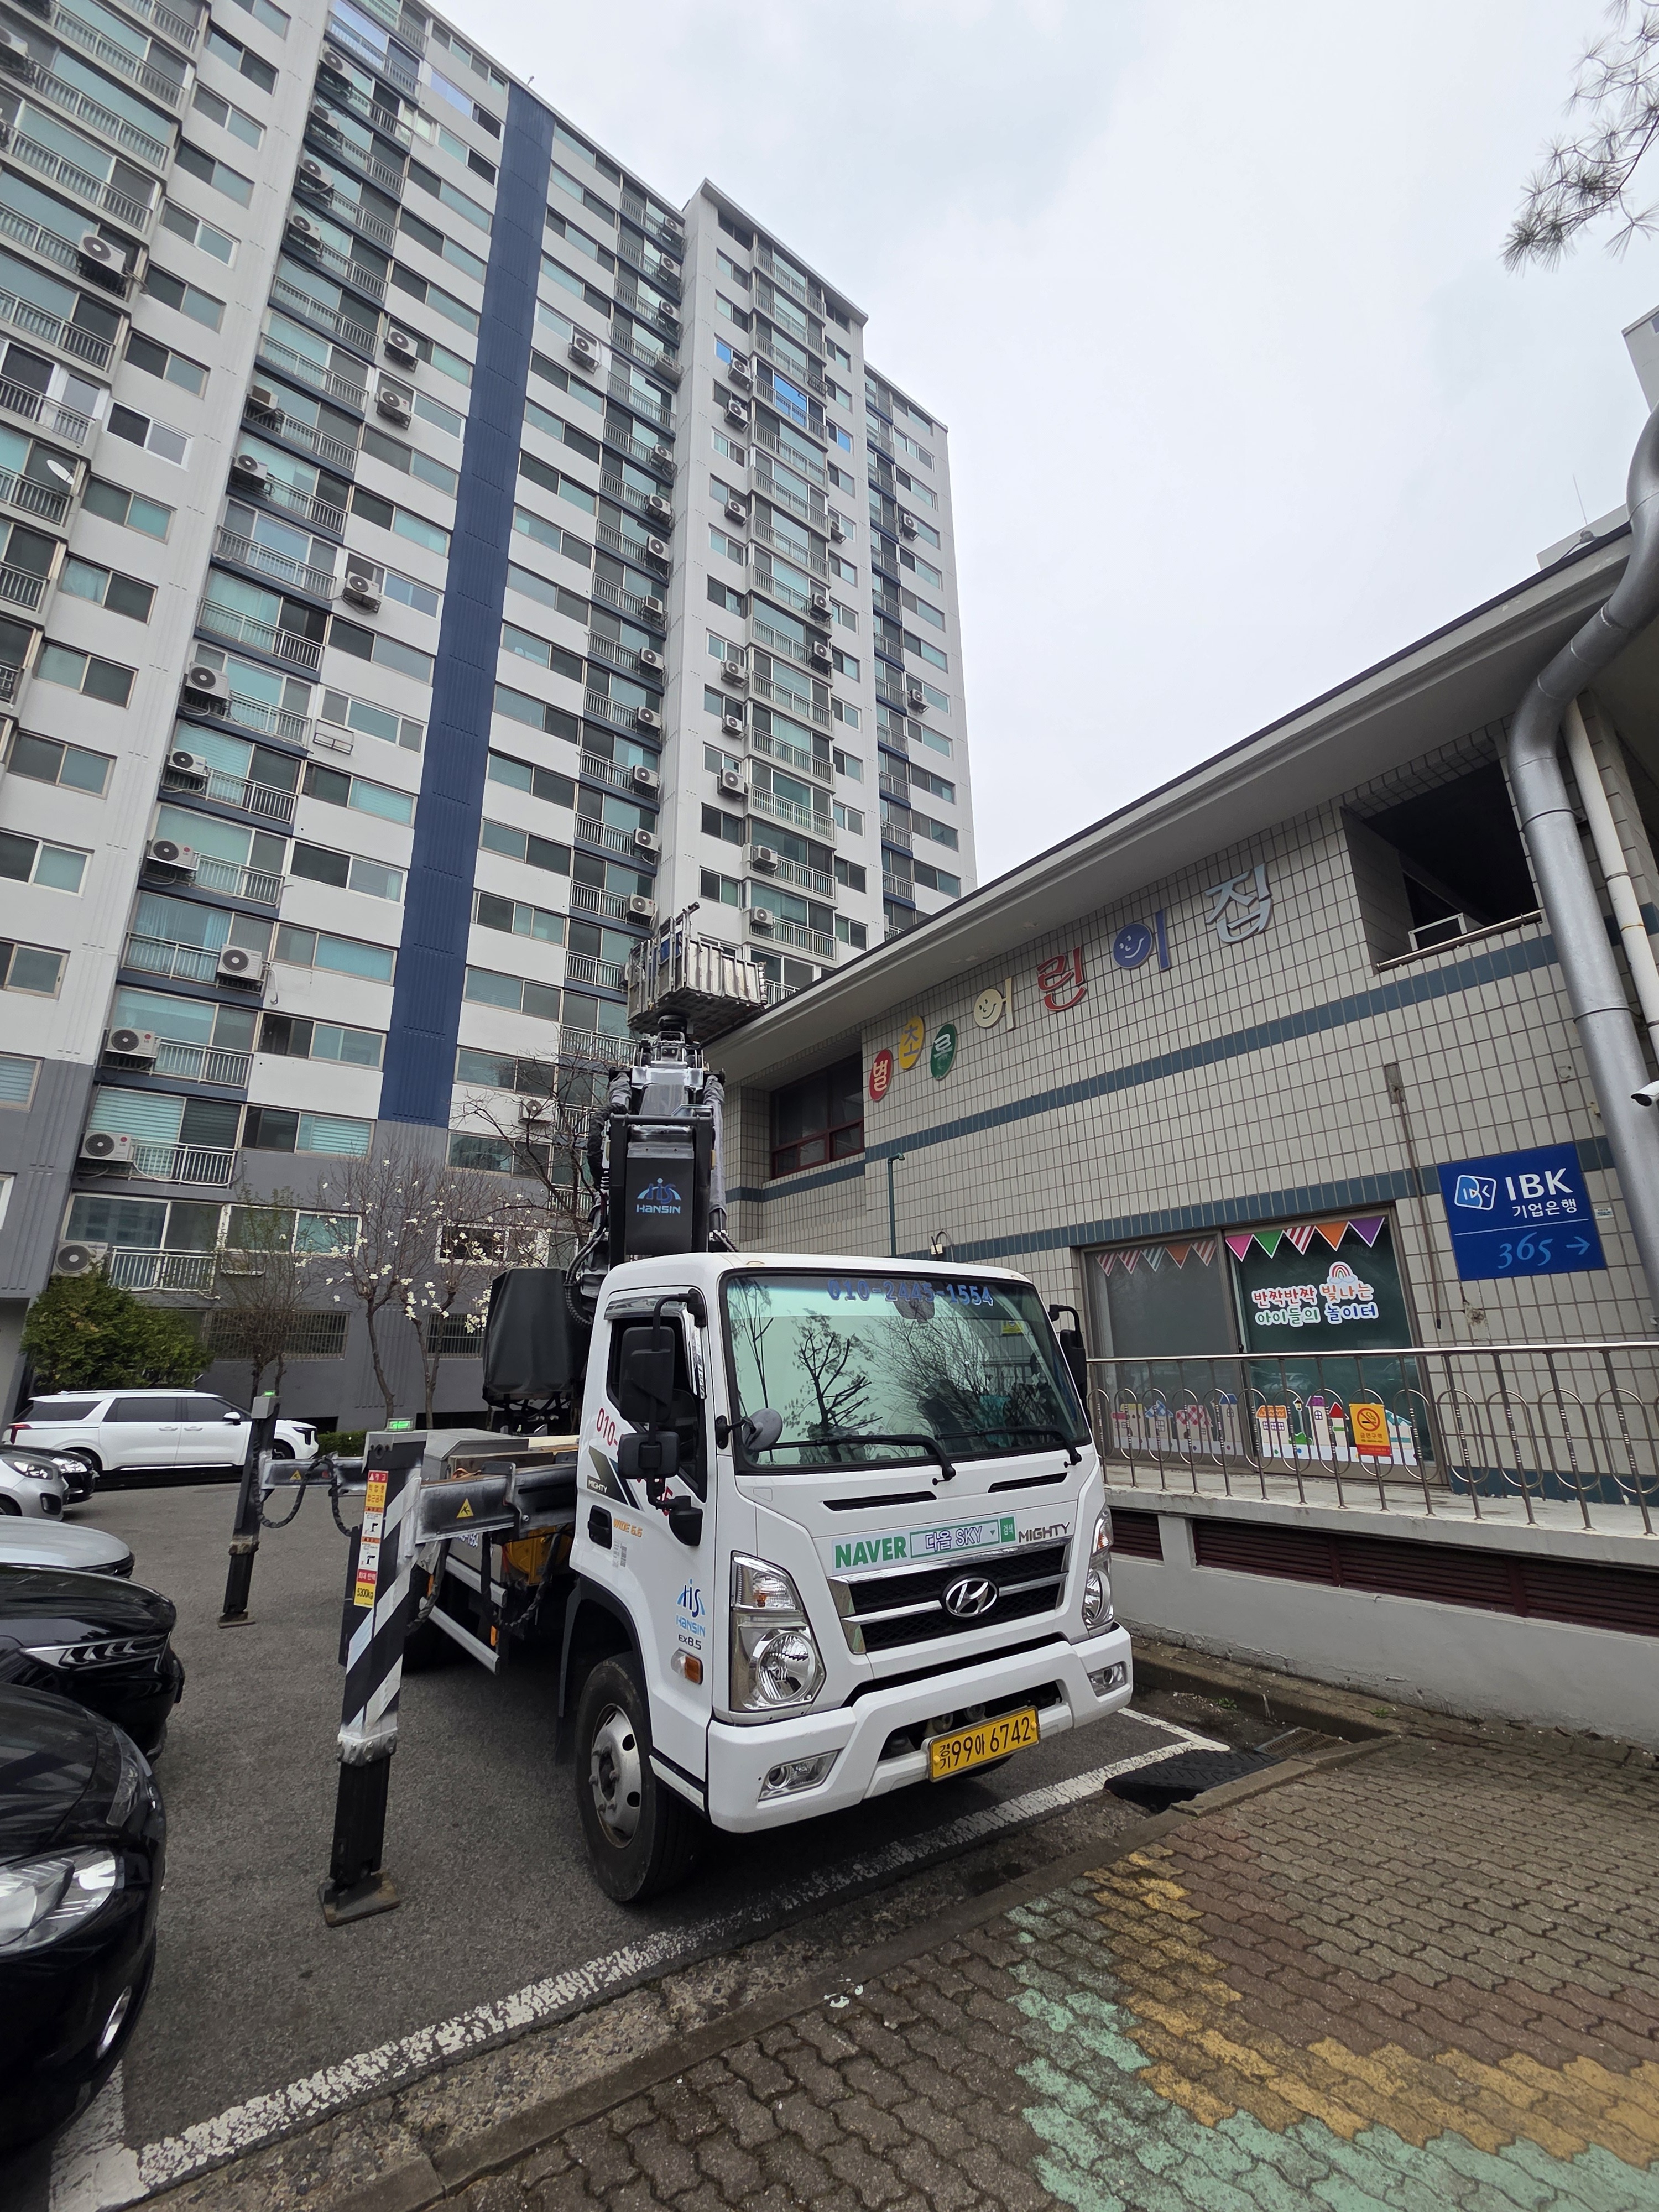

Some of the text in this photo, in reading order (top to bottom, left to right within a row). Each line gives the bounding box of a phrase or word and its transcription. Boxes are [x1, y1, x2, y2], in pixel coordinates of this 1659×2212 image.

[974, 863, 1272, 1031] 어린이집
[1505, 1168, 1574, 1201] IBK
[1511, 1198, 1577, 1219] 기업은행
[1498, 1232, 1553, 1269] 365
[827, 1279, 993, 1306] 010-2445-1554
[1254, 1283, 1371, 1307] 반짝반짝 빛나는
[1258, 1305, 1376, 1324] 아이들의 놀이터
[588, 1480, 607, 1493] MIGHTY
[613, 1518, 630, 1533] WIDE
[1018, 1522, 1071, 1543] MIGHTY
[835, 1536, 906, 1569] NAVER
[925, 1530, 952, 1552] 다올
[955, 1526, 983, 1546] SKY
[951, 1733, 985, 1766] 99아
[989, 1716, 1032, 1753] 6742
